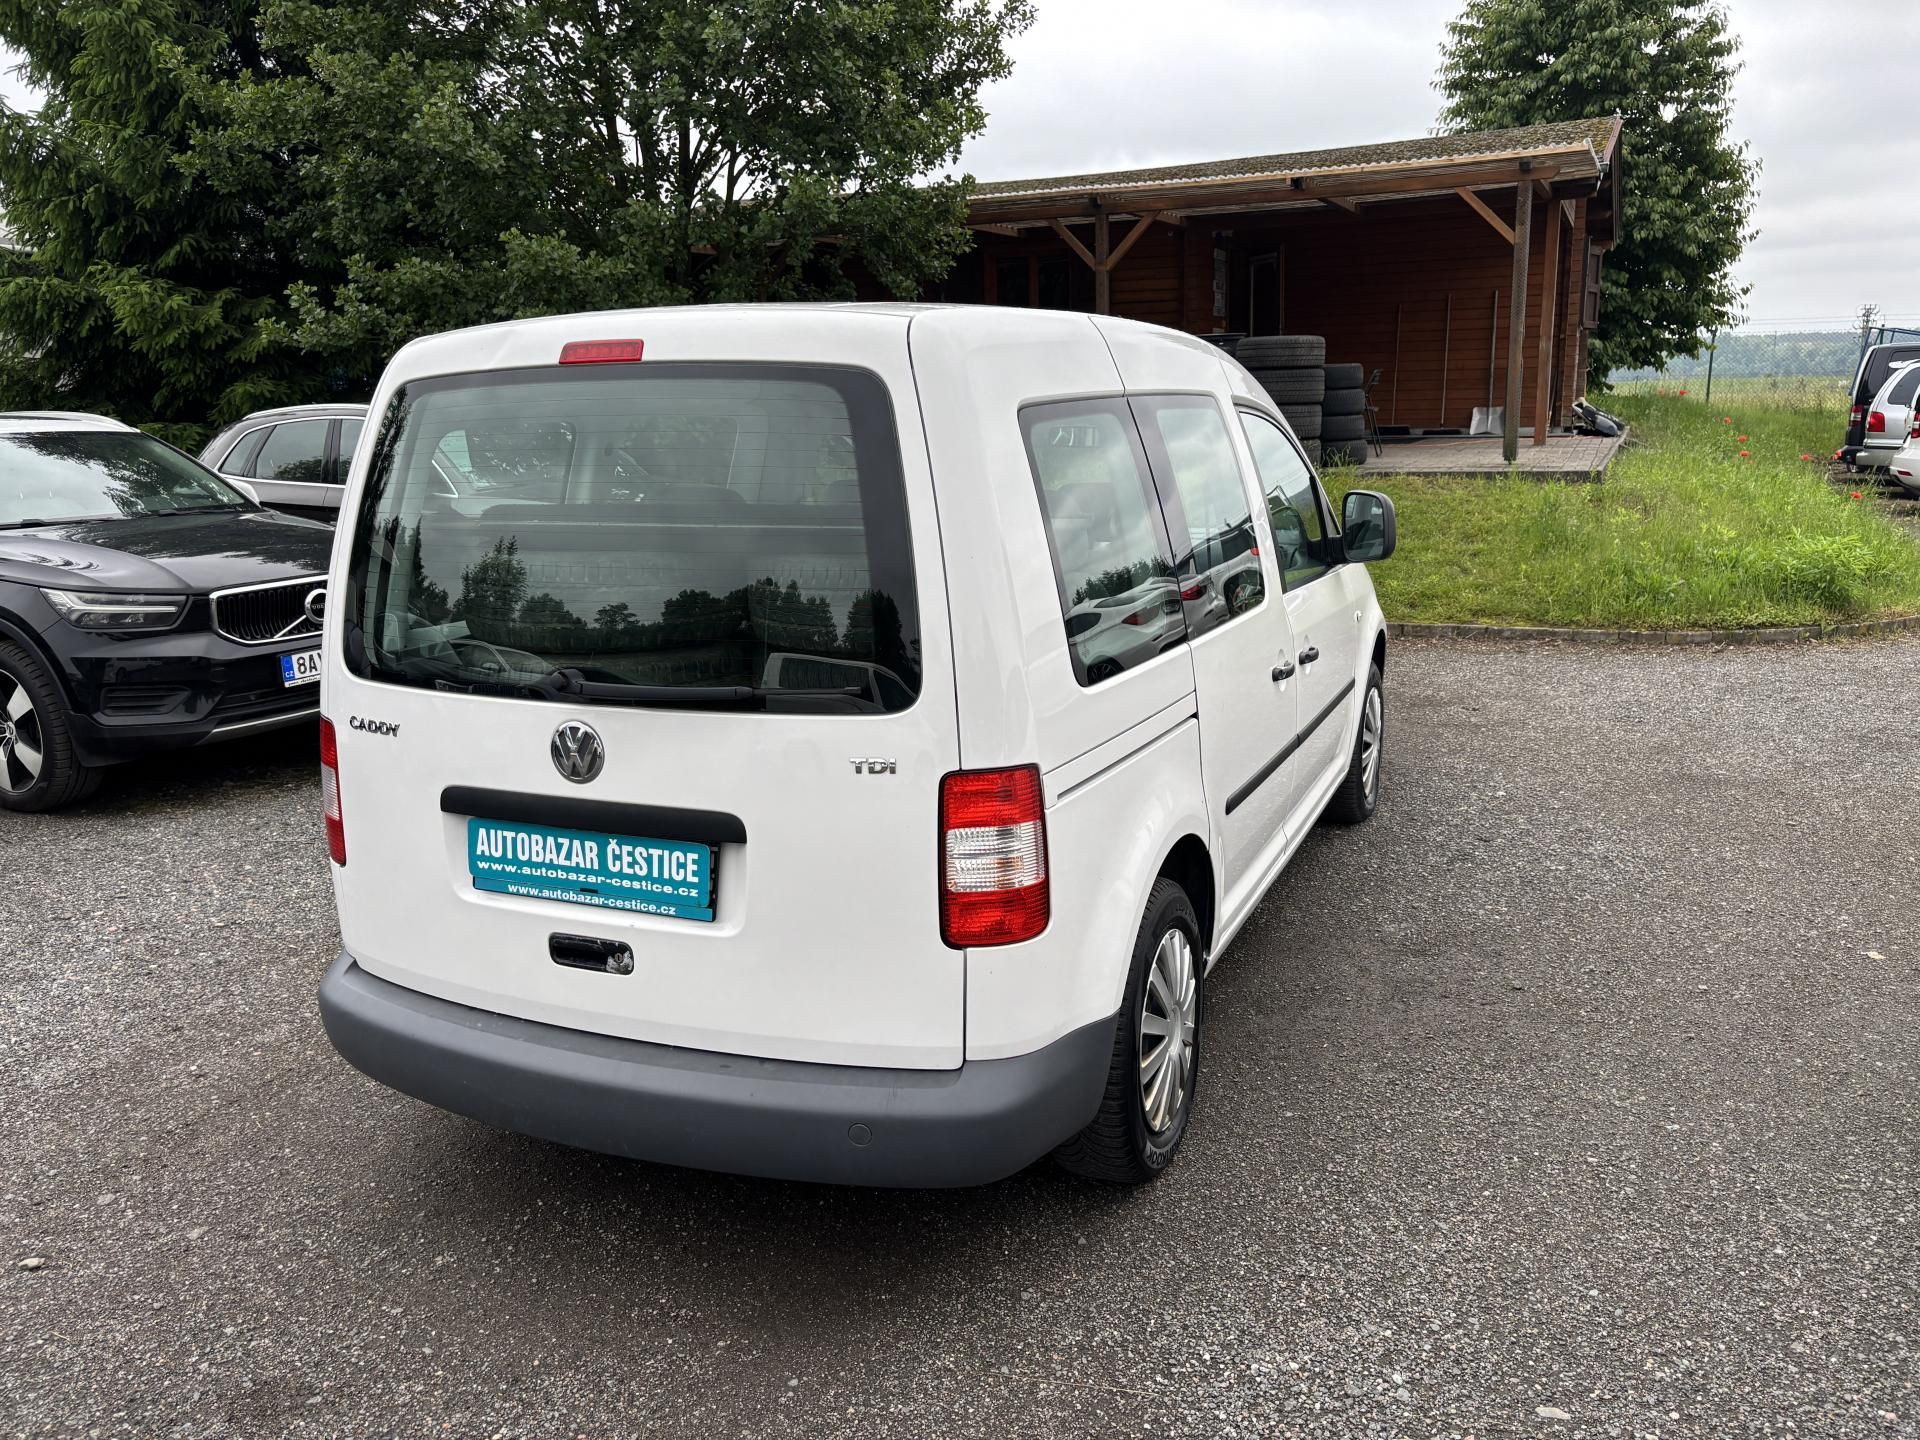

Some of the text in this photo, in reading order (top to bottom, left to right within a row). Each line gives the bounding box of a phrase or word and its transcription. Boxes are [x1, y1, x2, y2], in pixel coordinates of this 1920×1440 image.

[285, 670, 294, 678] CZ
[349, 715, 400, 738] CADDY
[849, 756, 896, 774] TDI
[476, 827, 699, 883] AUTOBAZAR ČESTICE
[476, 860, 698, 897] www.autobazar-cestice.cz
[507, 884, 676, 915] www.autobazar-cestice.cz
